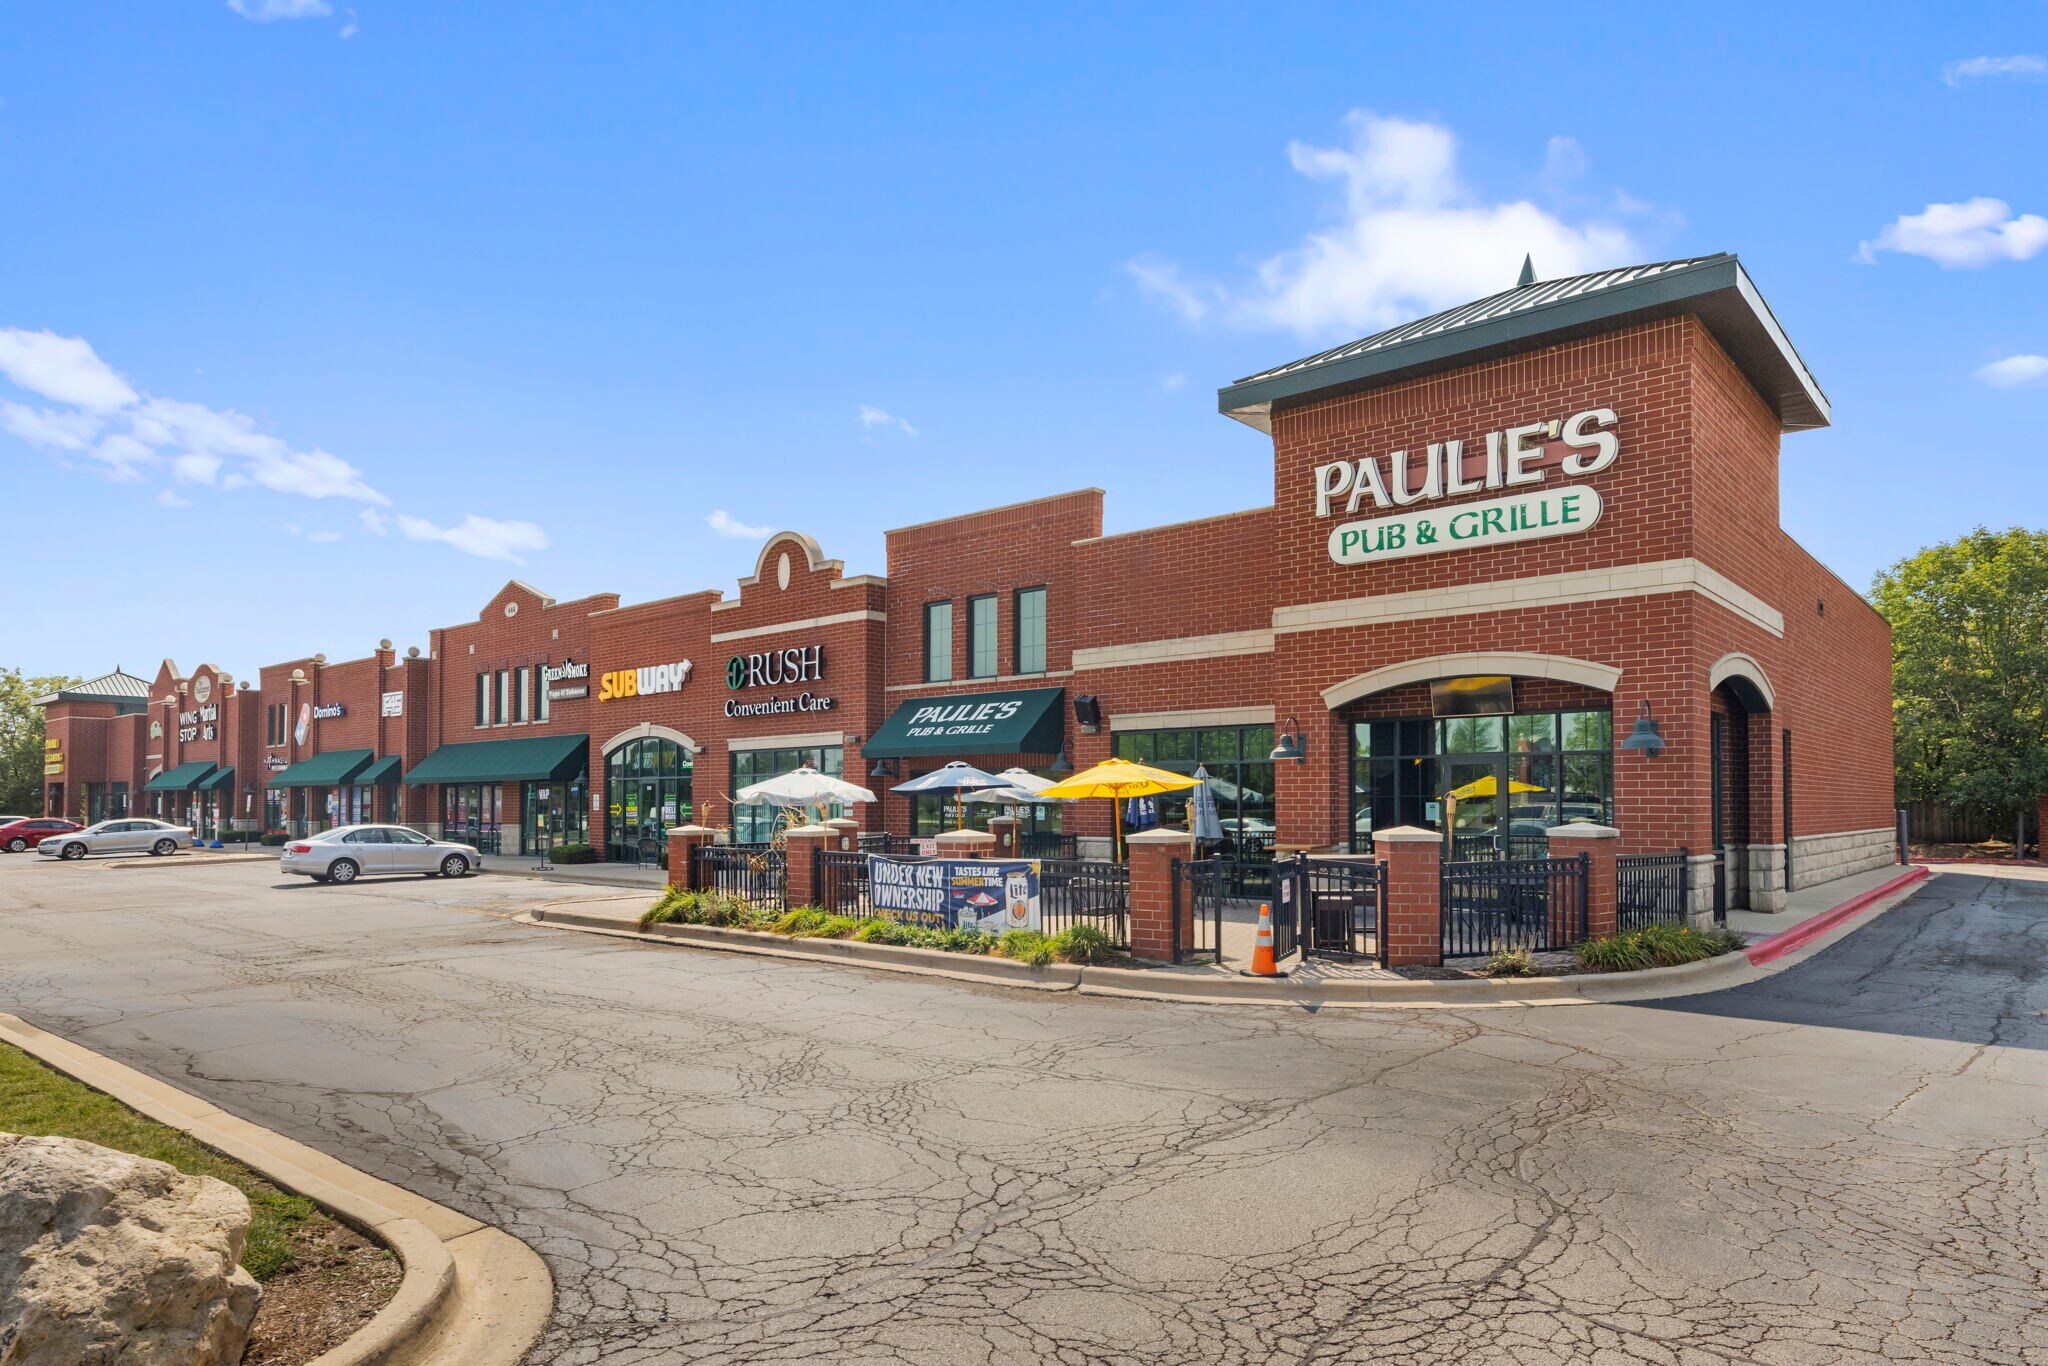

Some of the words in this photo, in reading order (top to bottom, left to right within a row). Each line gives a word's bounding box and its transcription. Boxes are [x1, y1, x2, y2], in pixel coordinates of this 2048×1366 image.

[1314, 408, 1618, 517] PAULIE'S
[1341, 523, 1406, 556] PUB
[1416, 520, 1439, 545] &
[1450, 495, 1580, 540] GRILLE
[567, 662, 587, 678] SMOKE
[748, 645, 823, 687] RUSH
[598, 659, 694, 702] SUBWAY
[314, 702, 341, 718] Domino's
[724, 696, 795, 718] Convenient
[799, 692, 831, 711] Care
[908, 701, 1023, 724] PAULIE'S
[180, 711, 197, 726] WING
[180, 727, 197, 742] STOP
[906, 726, 935, 737] PUB
[933, 726, 945, 736] &
[945, 724, 995, 735] GRILLE
[874, 862, 914, 886] UNDER
[916, 866, 944, 888] NEW
[954, 867, 981, 876] TASTES
[982, 867, 1000, 876] LIKE
[951, 877, 1004, 887] SUMMERTIME
[874, 884, 945, 911] OWNERSHIP
[1009, 883, 1027, 899] Lite
[874, 908, 904, 920] CHECK
[906, 911, 919, 922] US
